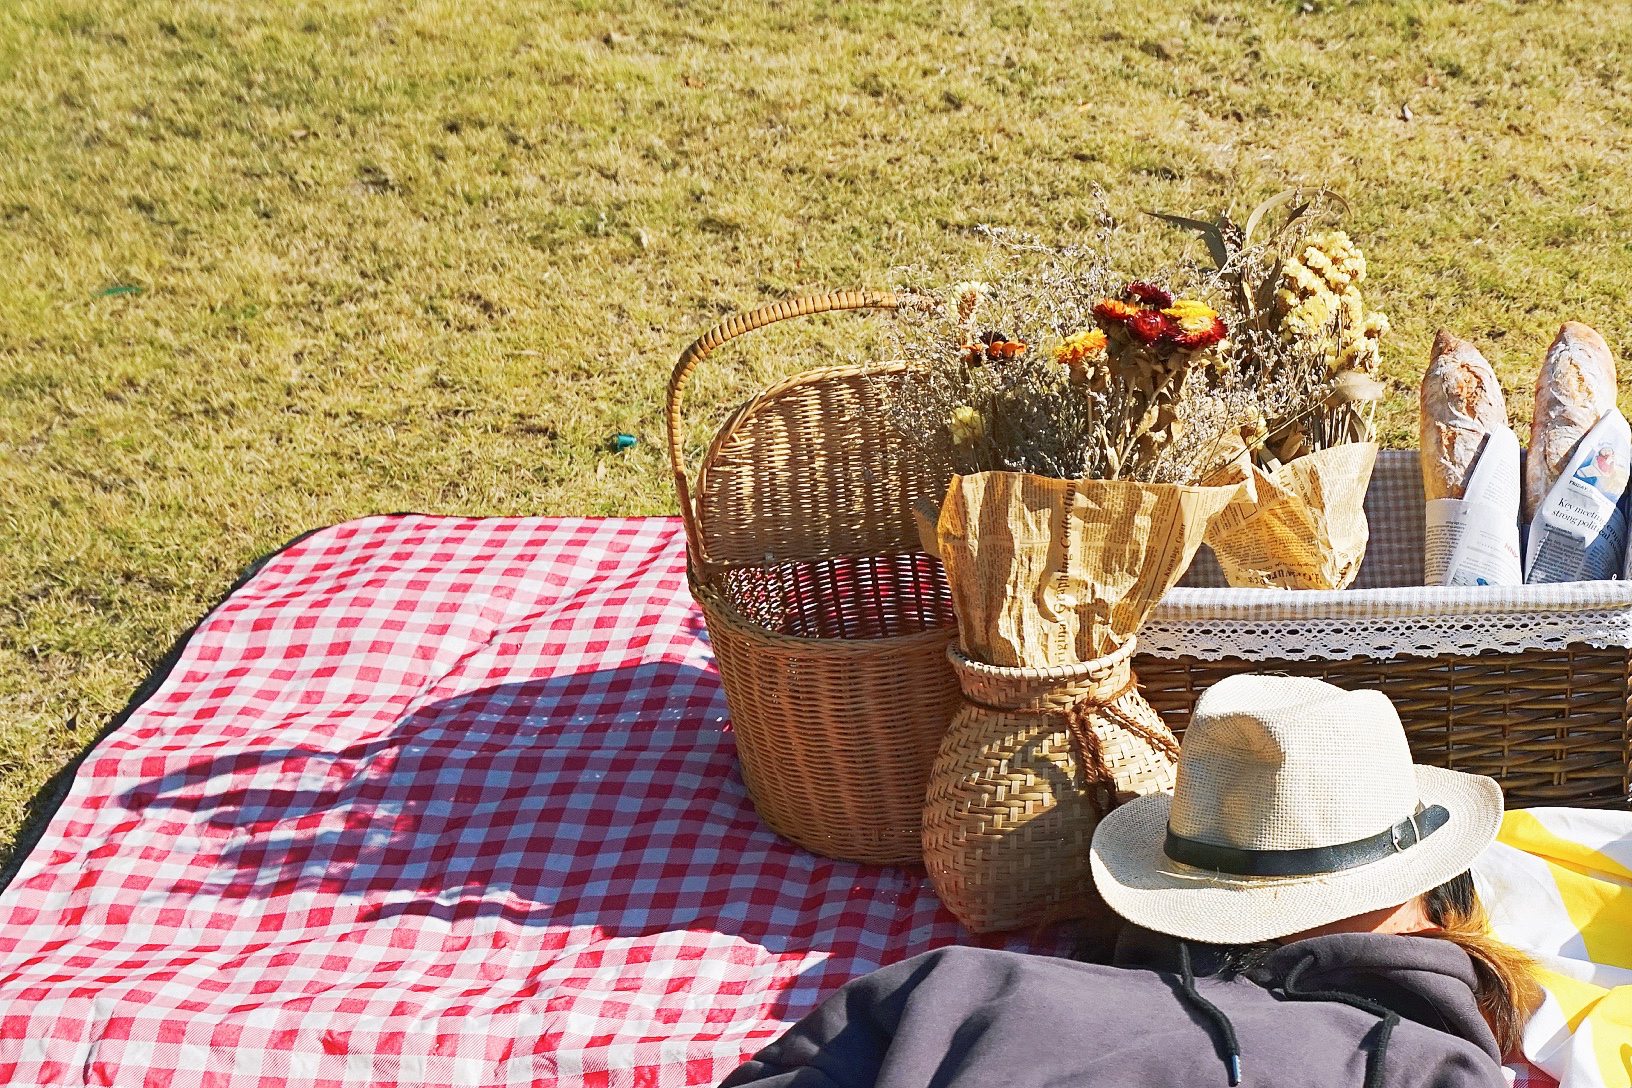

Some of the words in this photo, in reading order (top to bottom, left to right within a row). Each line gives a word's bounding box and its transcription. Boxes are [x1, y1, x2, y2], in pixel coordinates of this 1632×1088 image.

[1558, 498, 1573, 512] Key
[1552, 510, 1577, 525] strong
[1577, 519, 1611, 541] political
[1054, 618, 1068, 665] riginal
[1061, 482, 1076, 549] Collection
